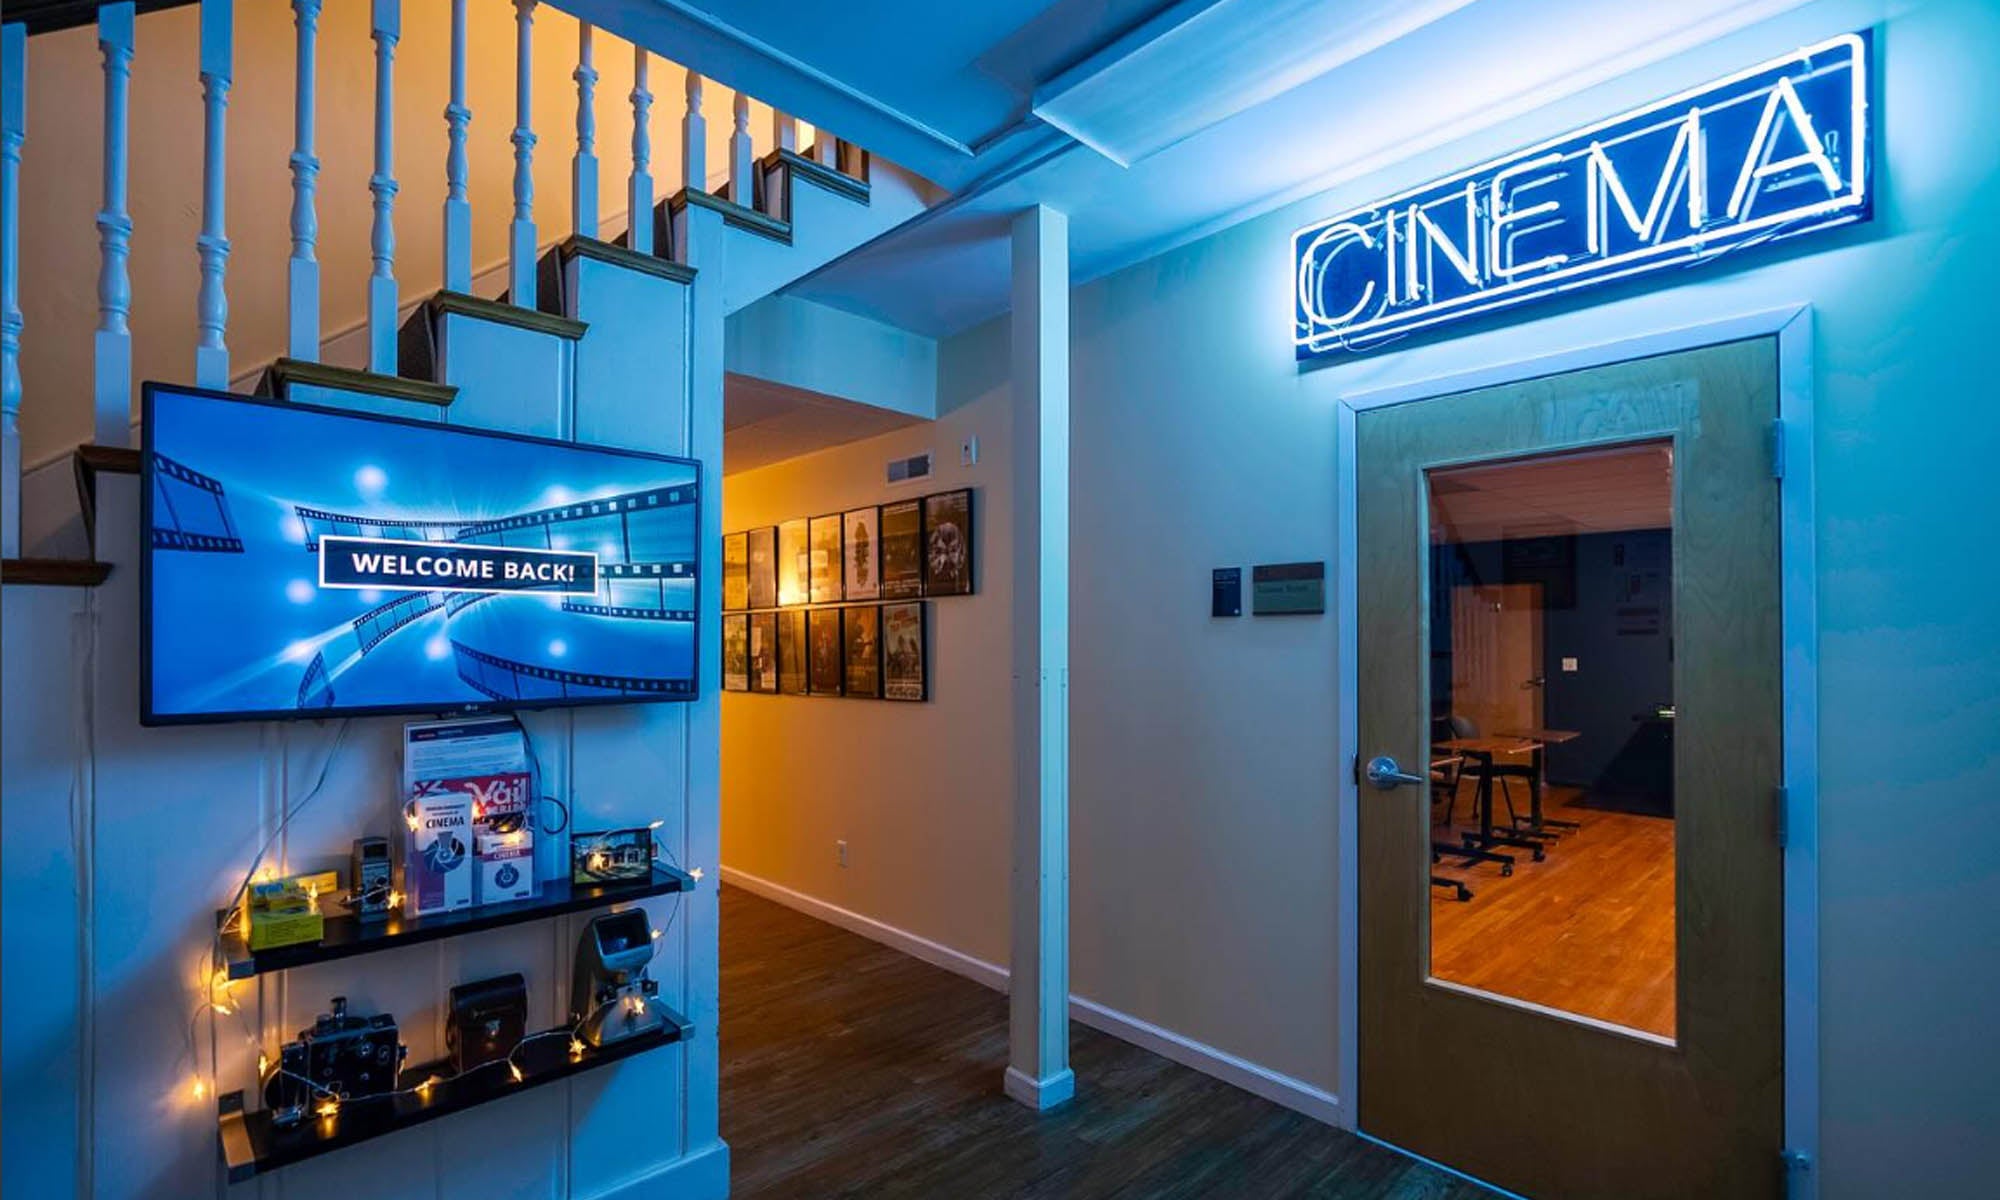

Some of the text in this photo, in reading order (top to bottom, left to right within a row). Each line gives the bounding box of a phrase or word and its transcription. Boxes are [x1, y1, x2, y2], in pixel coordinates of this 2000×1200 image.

[1299, 76, 1843, 327] CINEMA
[351, 552, 575, 582] WELCOME BACK!
[426, 816, 464, 829] CINEMA
